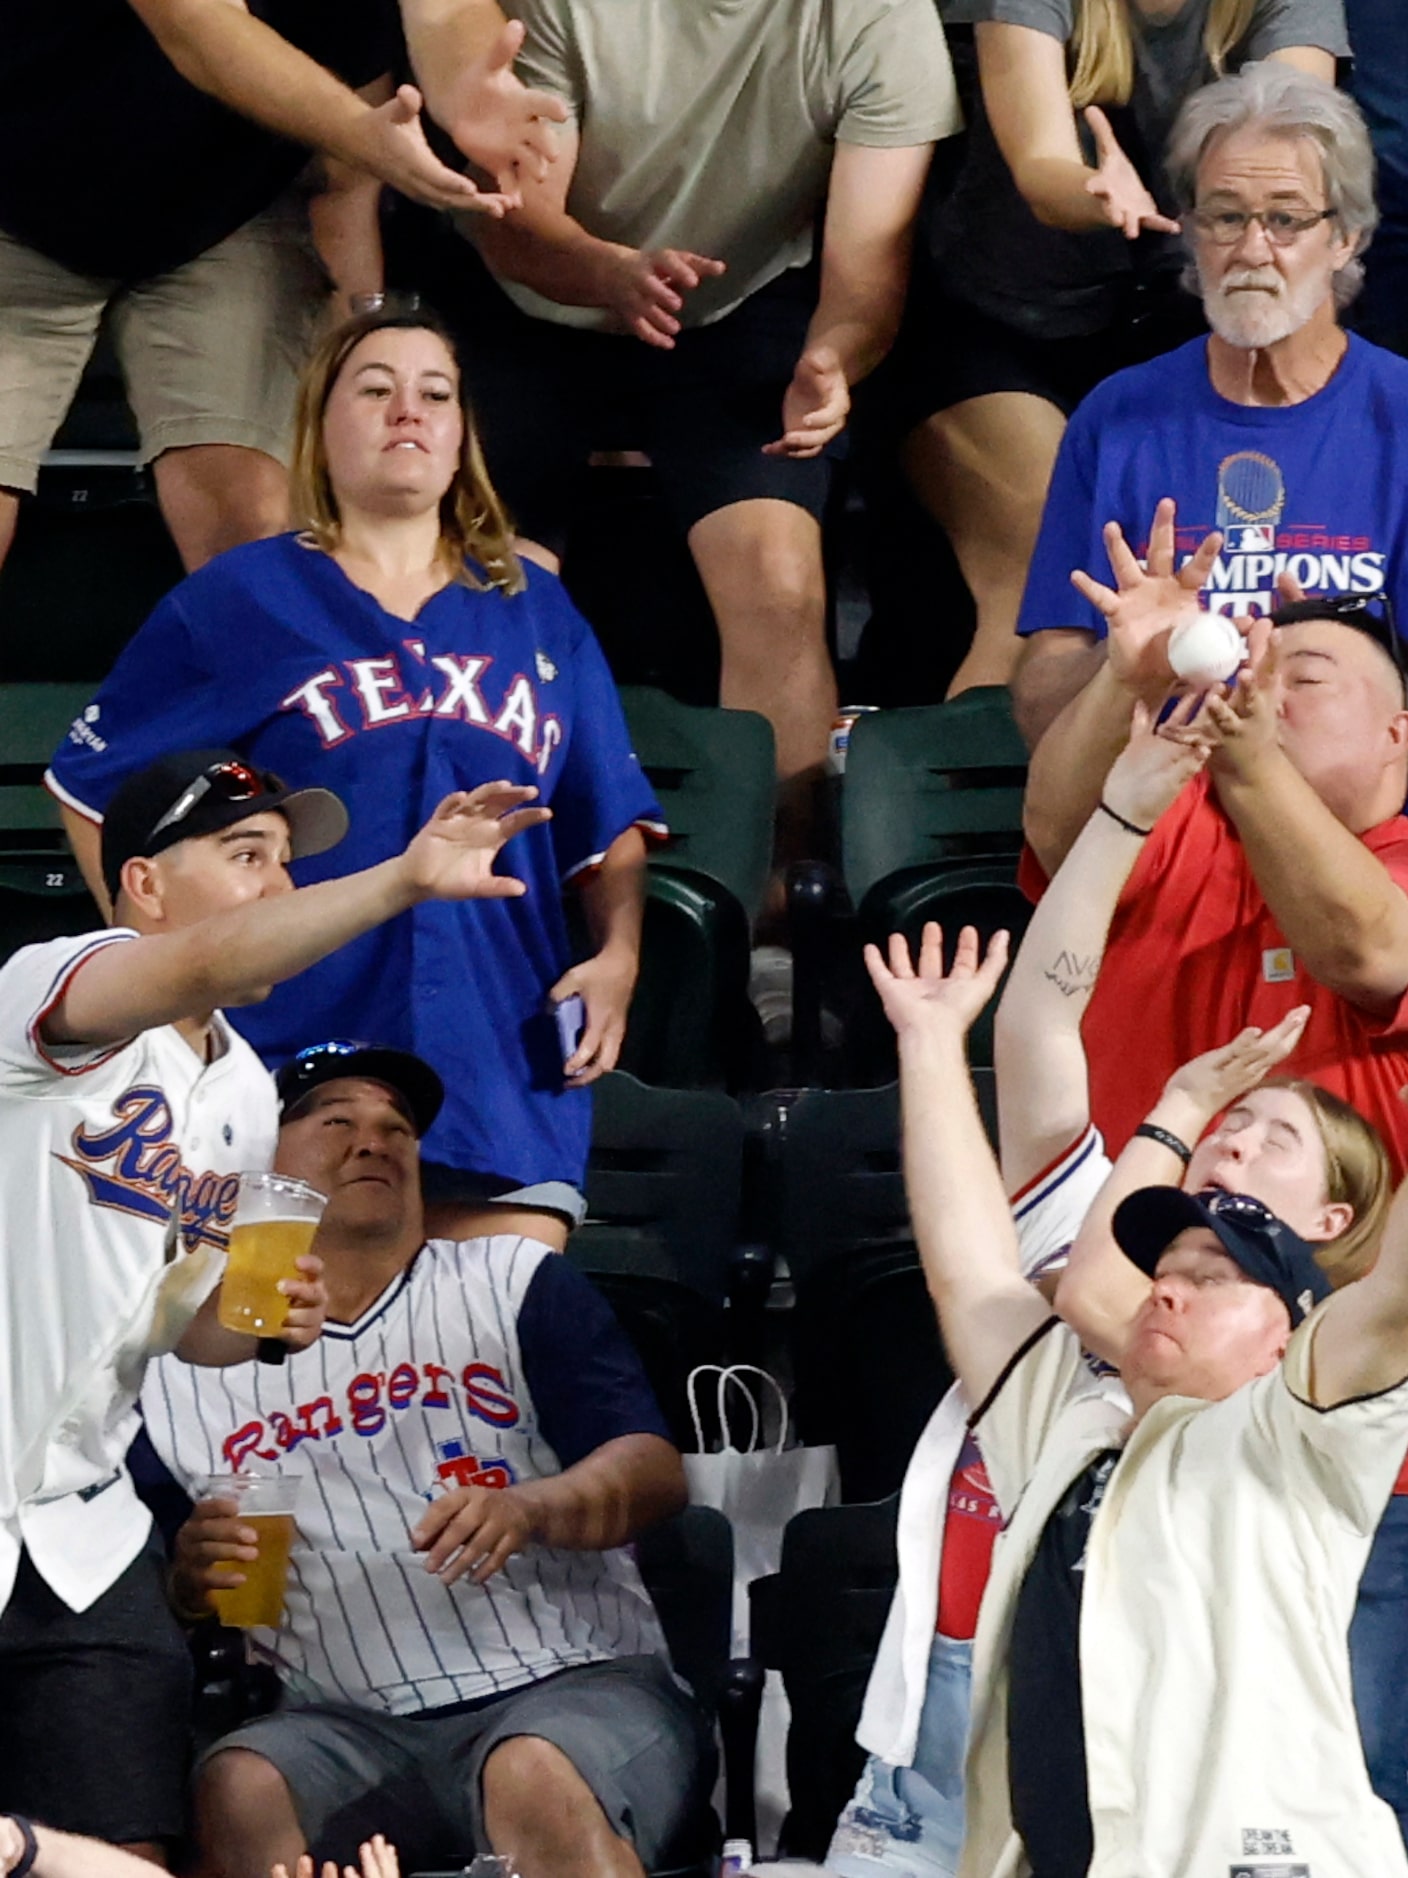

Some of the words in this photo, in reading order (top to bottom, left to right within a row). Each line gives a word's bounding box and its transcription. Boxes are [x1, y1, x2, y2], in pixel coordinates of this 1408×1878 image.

[1276, 533, 1371, 551] SERIES
[279, 638, 562, 776] TEXAS
[45, 872, 64, 887] 22
[70, 1083, 242, 1254] Range
[221, 1362, 520, 1475] Rangers
